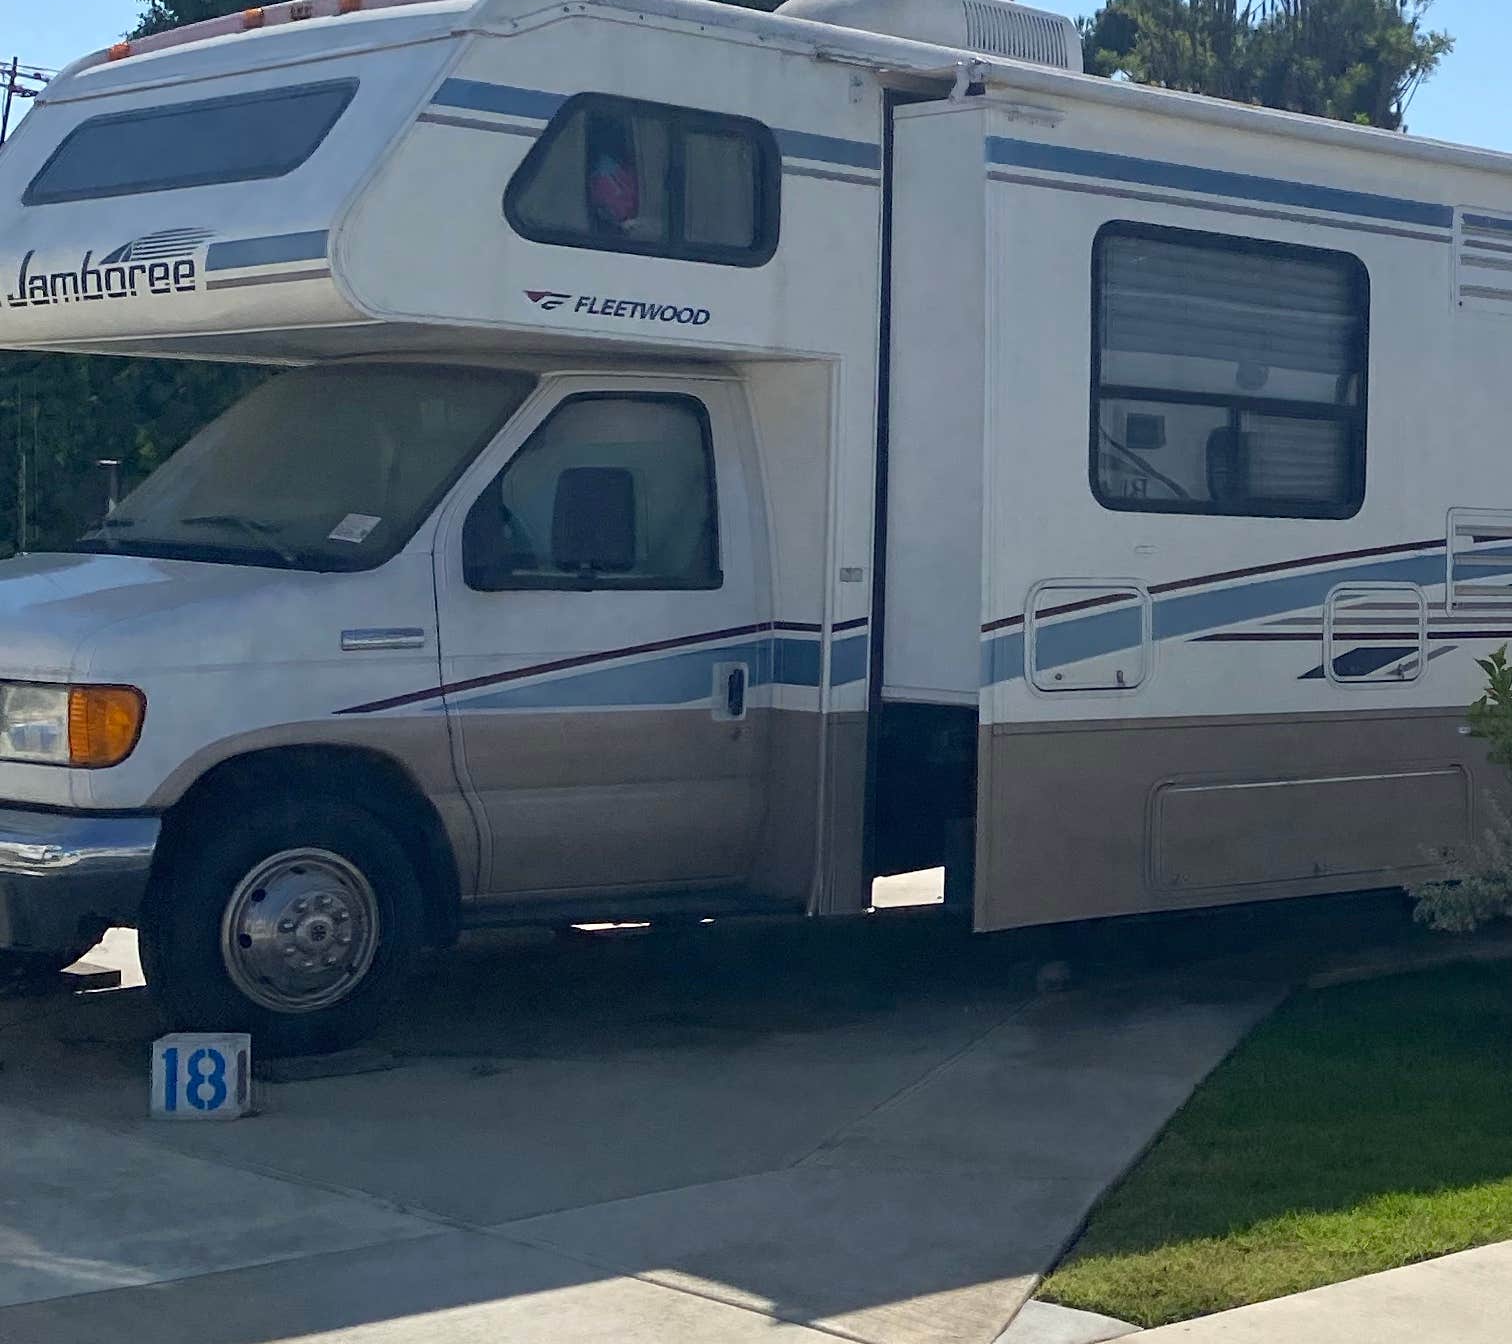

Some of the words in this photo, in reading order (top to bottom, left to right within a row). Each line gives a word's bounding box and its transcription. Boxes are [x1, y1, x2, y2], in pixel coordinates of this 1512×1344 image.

[7, 250, 196, 307] Jamboree
[574, 295, 711, 326] FLEETWOOD
[161, 1047, 227, 1112] 18
